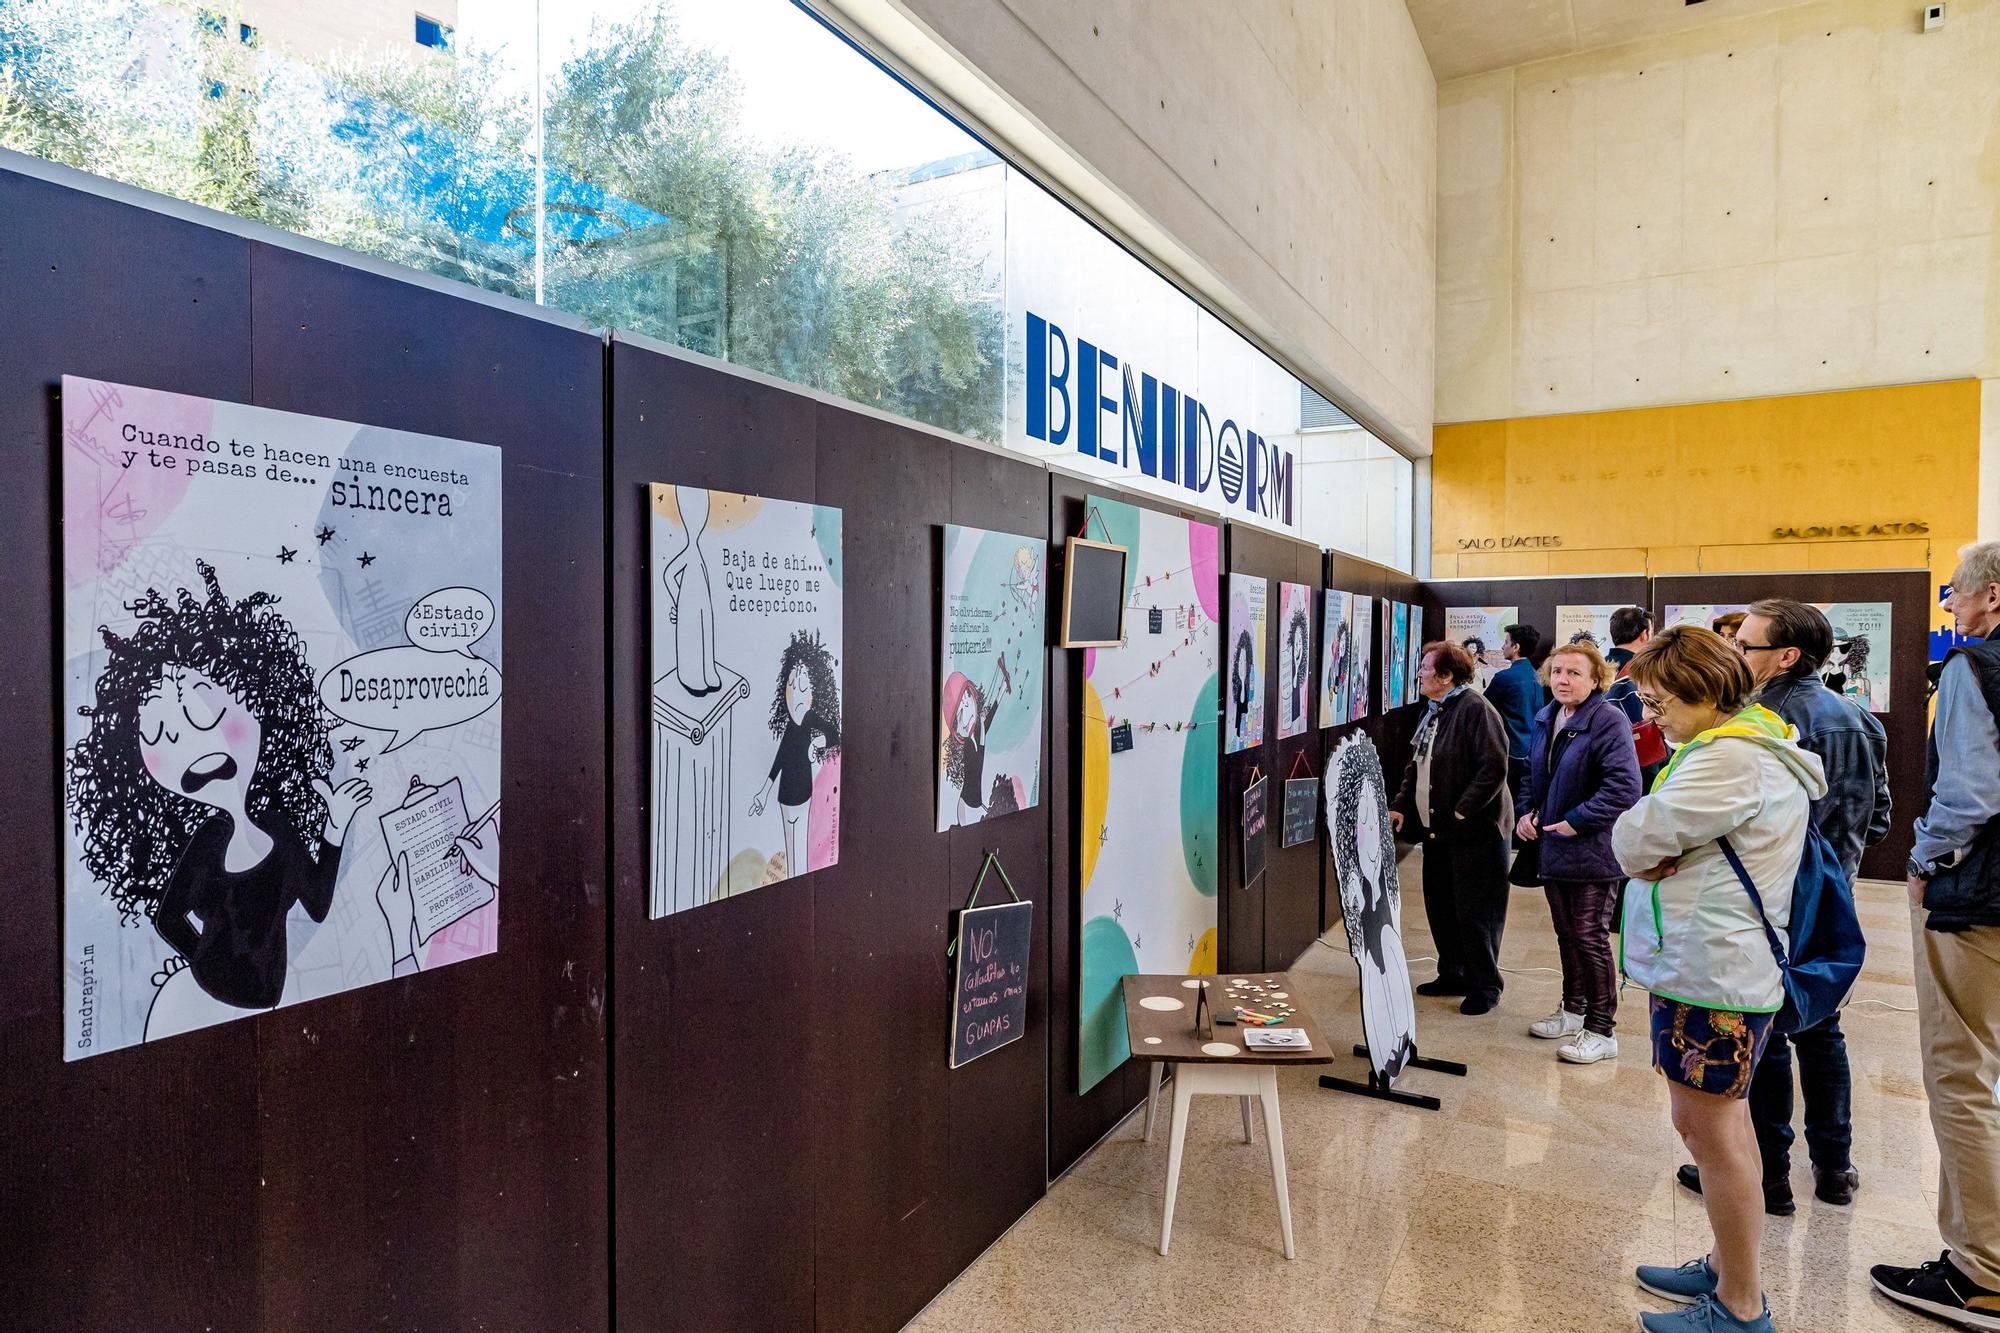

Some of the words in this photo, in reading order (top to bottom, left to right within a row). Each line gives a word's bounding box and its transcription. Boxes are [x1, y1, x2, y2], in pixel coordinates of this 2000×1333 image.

[1026, 310, 1293, 526] BENIDORM
[121, 450, 138, 469] y
[148, 449, 176, 469] te
[185, 458, 257, 478] pasas
[265, 464, 316, 485] de...
[122, 424, 220, 453] Cuando
[229, 438, 255, 458] te
[263, 443, 330, 468] hacen
[338, 457, 377, 474] una
[383, 464, 469, 486] encuesta
[332, 475, 453, 517] sincera
[1501, 535, 1562, 548] D'ACTES
[1837, 524, 1862, 537] DE
[1867, 522, 1929, 536] ACTOS
[722, 548, 756, 572] Baja
[762, 552, 778, 569] de
[784, 554, 822, 571] ahí...
[726, 571, 753, 591] Que
[759, 574, 800, 595] luego
[805, 580, 820, 592] me
[413, 605, 484, 621] ¿Estado
[729, 594, 817, 616] decepciono.
[950, 606, 959, 617] No
[960, 606, 993, 617] olvidarme
[419, 622, 479, 637] civil?
[949, 622, 958, 632] de
[959, 622, 981, 632] afinar
[982, 622, 990, 632] la
[340, 667, 489, 710] Desaprovechá
[394, 809, 427, 831] ESTADO
[428, 797, 453, 814] CIVIL
[413, 831, 455, 859] ESTUDIOS
[429, 882, 475, 914] PROFESIÓN
[969, 919, 998, 964] NO!
[78, 944, 97, 1049] Sandraprim
[963, 992, 998, 1014] estamos
[966, 1014, 1010, 1045] GUAPAS
